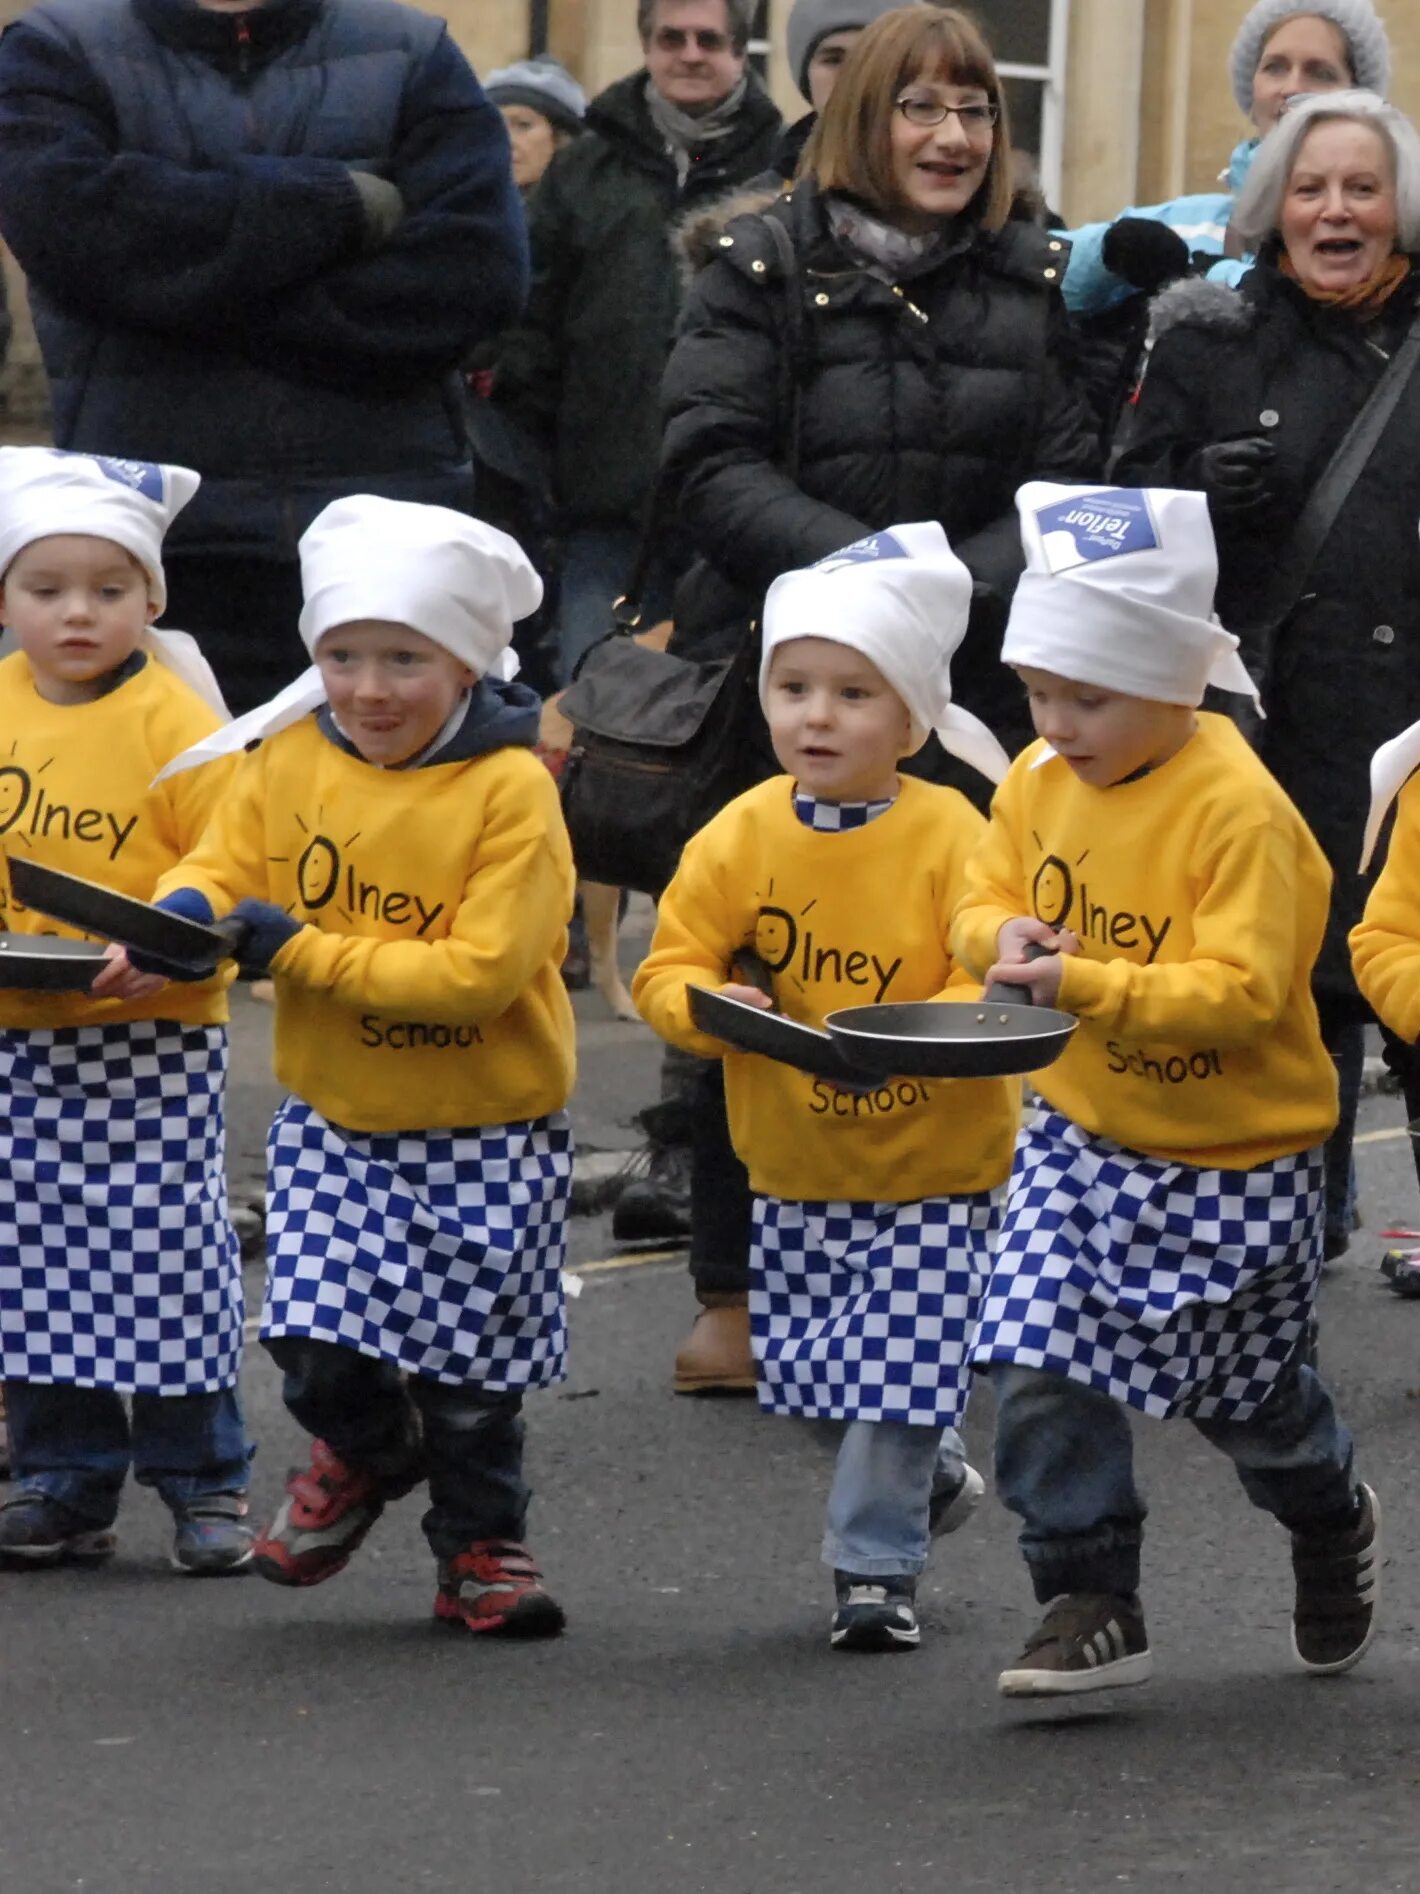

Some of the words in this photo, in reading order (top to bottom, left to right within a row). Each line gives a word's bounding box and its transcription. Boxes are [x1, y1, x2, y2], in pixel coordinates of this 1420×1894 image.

[298, 835, 444, 936] Olney
[1032, 855, 1172, 963] Olney
[1106, 1041, 1223, 1083] School
